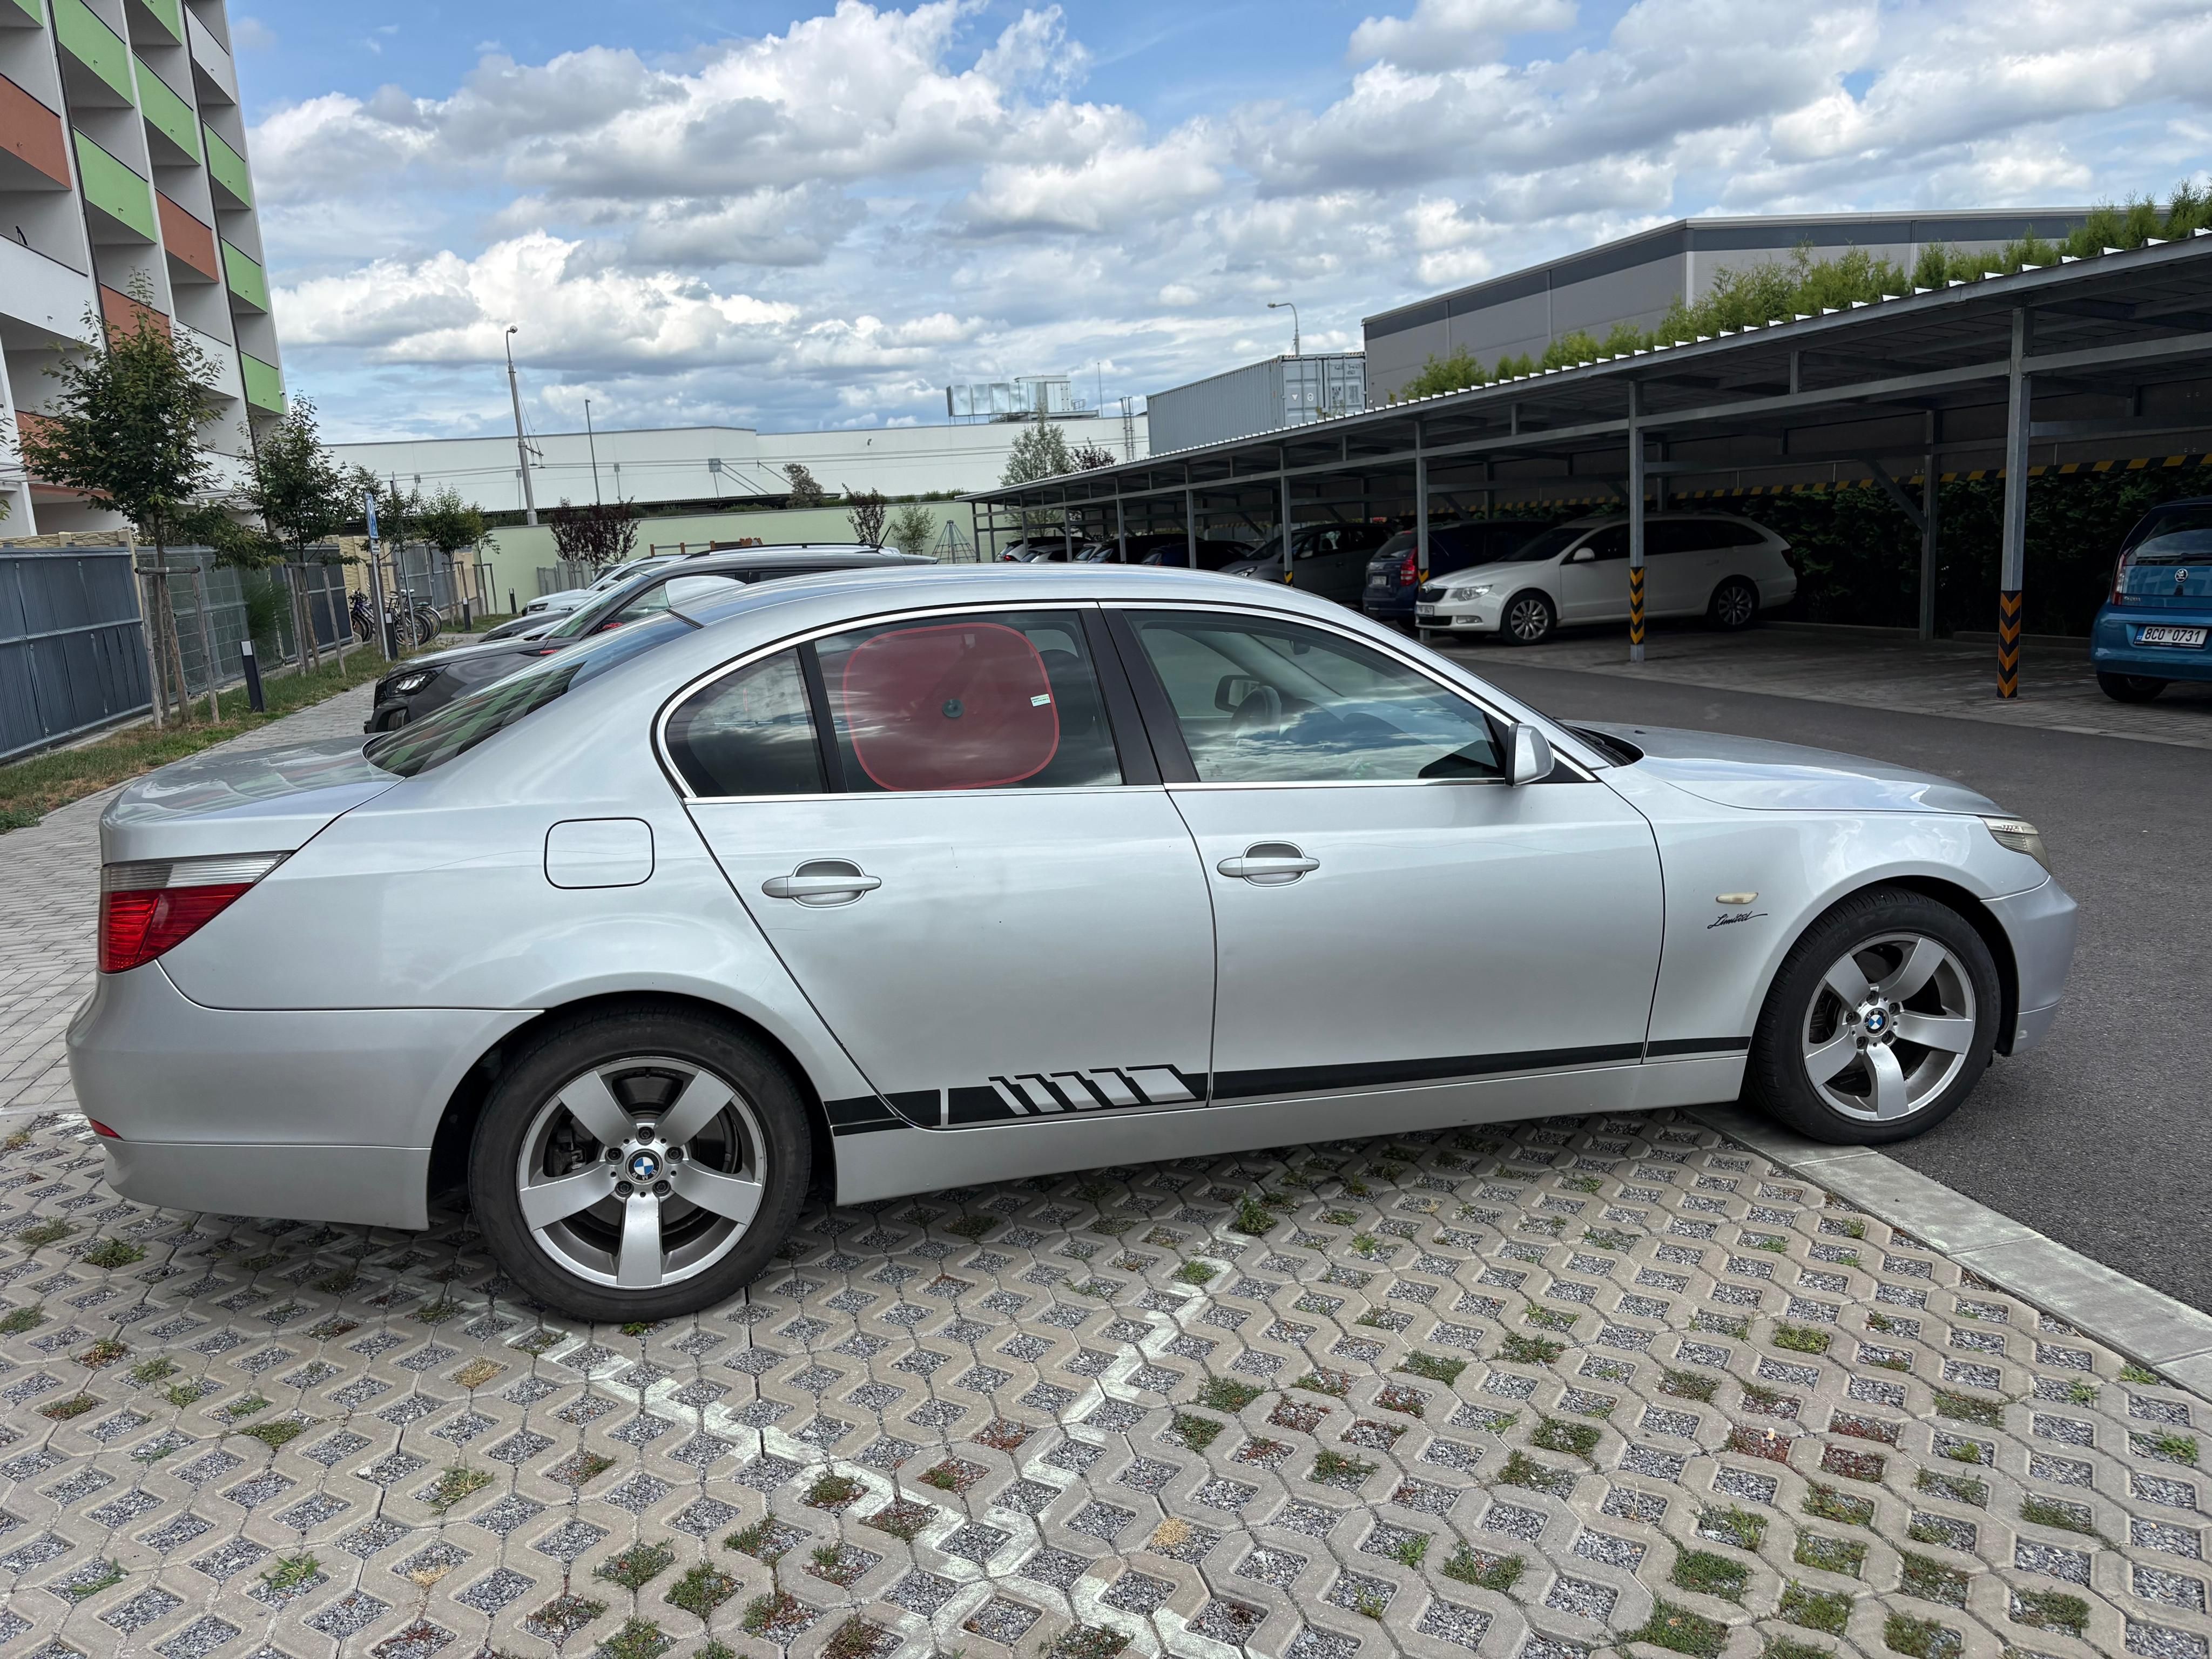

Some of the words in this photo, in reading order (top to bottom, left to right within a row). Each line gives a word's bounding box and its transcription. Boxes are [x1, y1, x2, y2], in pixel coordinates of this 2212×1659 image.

[2172, 630, 2201, 642] 0731
[1707, 911, 1768, 929] Limited
[632, 1170, 657, 1180] BMW
